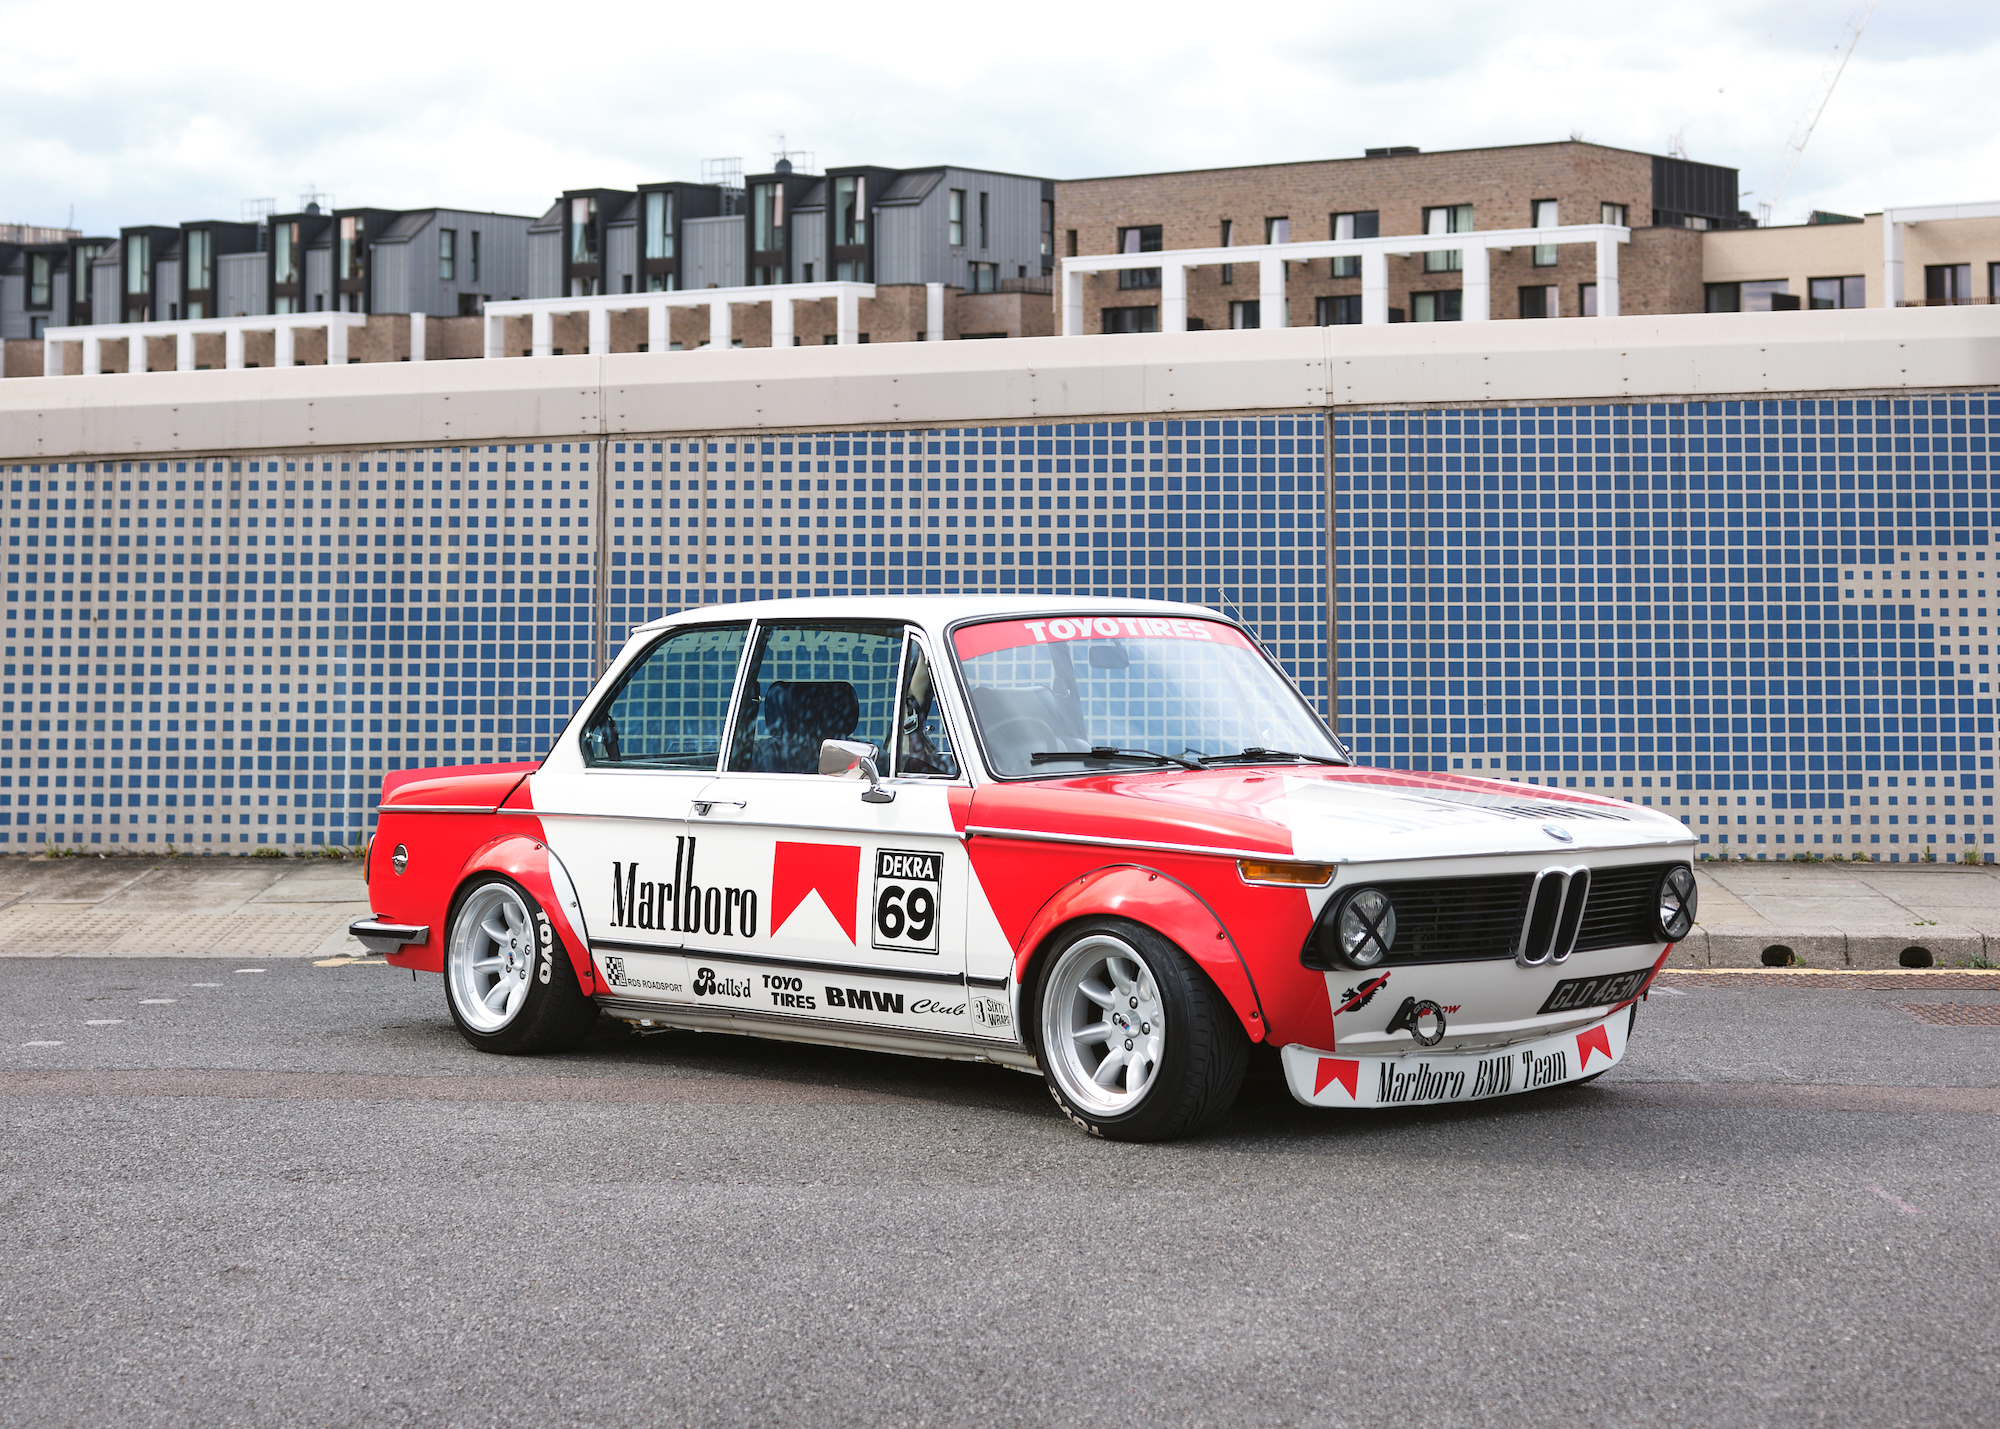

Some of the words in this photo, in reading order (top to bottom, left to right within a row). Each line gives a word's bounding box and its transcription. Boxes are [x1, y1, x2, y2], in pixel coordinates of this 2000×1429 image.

[1024, 617, 1121, 642] TOYO
[1117, 617, 1212, 640] TIRES
[882, 854, 935, 879] DEKRA
[610, 836, 758, 938] Marlboro
[877, 885, 935, 942] 69
[627, 978, 641, 987] RDS
[642, 980, 683, 993] ROADSPORT
[762, 974, 803, 992] TOYO
[1592, 972, 1647, 1004] 463N
[771, 992, 816, 1010] TIRES
[825, 986, 904, 1014] BMW
[910, 998, 967, 1016] Club
[986, 999, 1005, 1014] SIXTY
[988, 1013, 1011, 1027] WRAPS
[1375, 1062, 1465, 1103] Marlboro
[1470, 1054, 1515, 1098] BMW
[1522, 1050, 1567, 1090] Team
